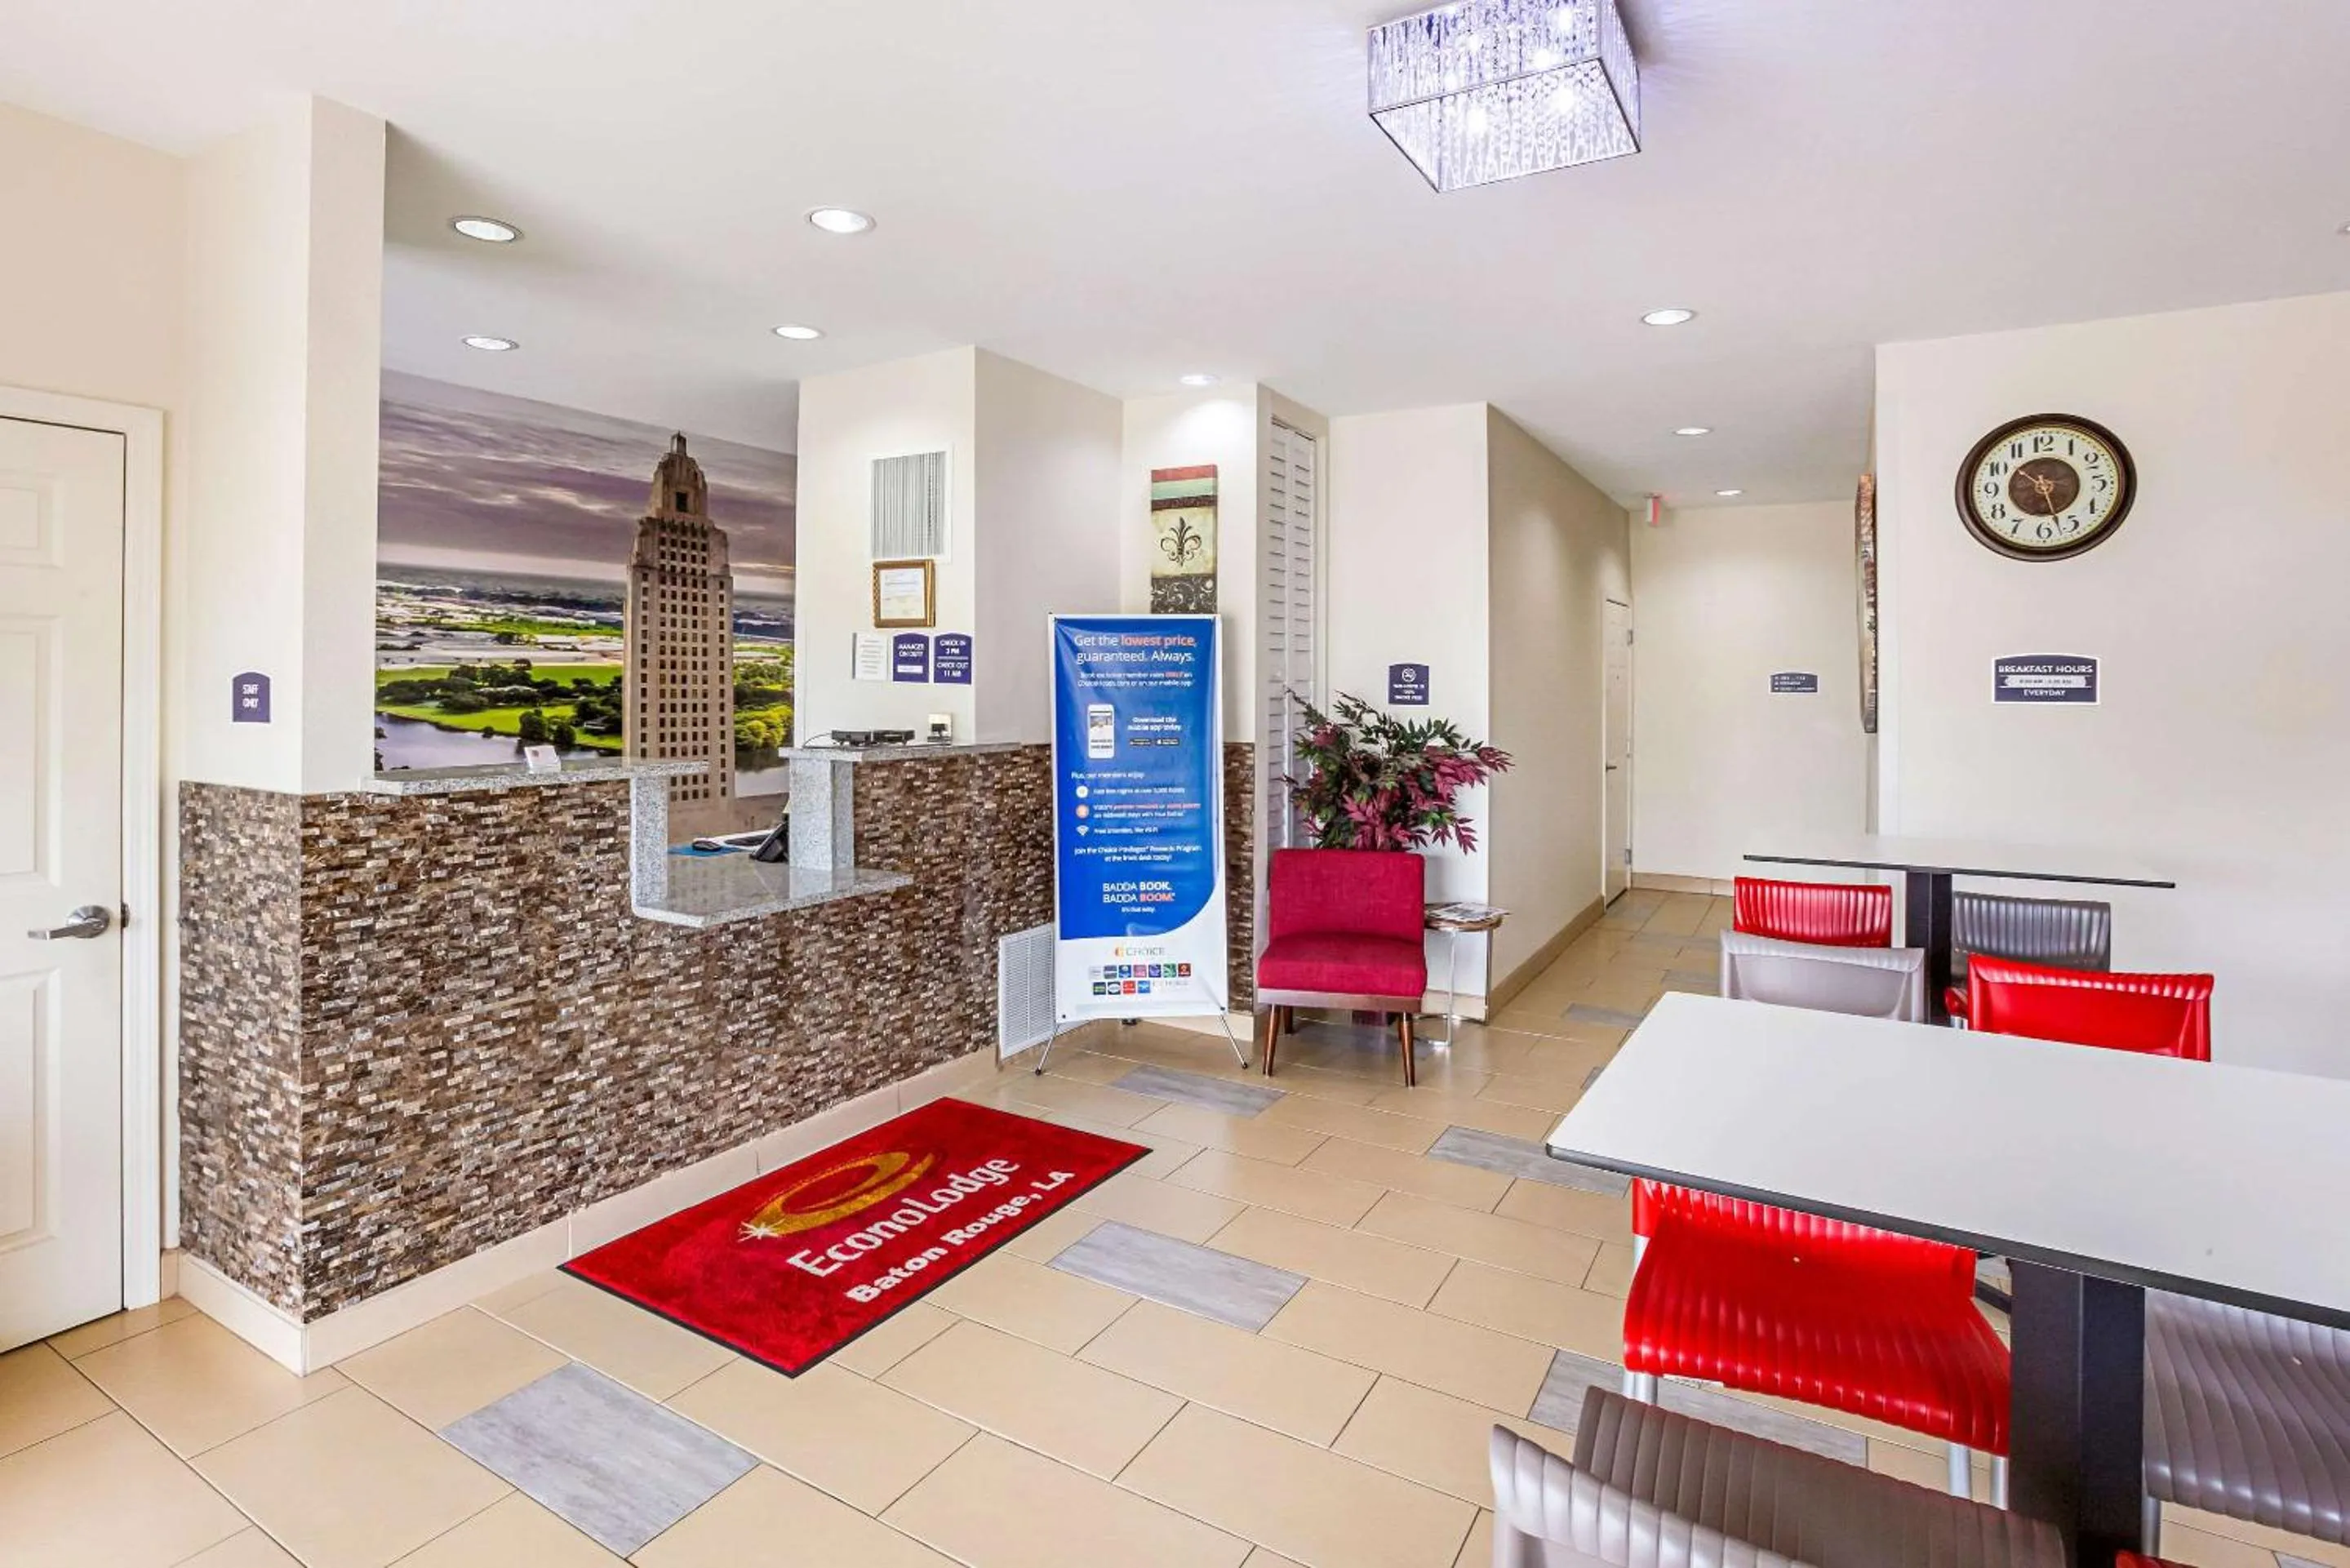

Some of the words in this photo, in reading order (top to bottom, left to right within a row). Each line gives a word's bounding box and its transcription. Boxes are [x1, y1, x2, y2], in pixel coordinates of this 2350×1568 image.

[2010, 442, 2023, 459] 11
[2033, 435, 2054, 453] 12
[2068, 438, 2074, 455] 1
[1989, 461, 2008, 477] 10
[2084, 452, 2099, 471] 2
[1984, 482, 1999, 499] 9
[2092, 474, 2107, 492] 3
[1991, 503, 2006, 519] 8
[2010, 518, 2024, 534] 7
[2036, 522, 2052, 540] 6
[2063, 515, 2080, 533] 5
[1074, 635, 1095, 646] Get
[1099, 635, 1119, 646] the
[1121, 635, 1161, 646] lowest
[1077, 651, 1148, 665] guaranteed.
[1151, 651, 1196, 665] Always.
[1103, 882, 1137, 891] BADDA
[1103, 894, 1137, 903] BADDA
[846, 1246, 948, 1303] Baton
[940, 1193, 1043, 1246] Rouge,
[1031, 1170, 1076, 1190] LA
